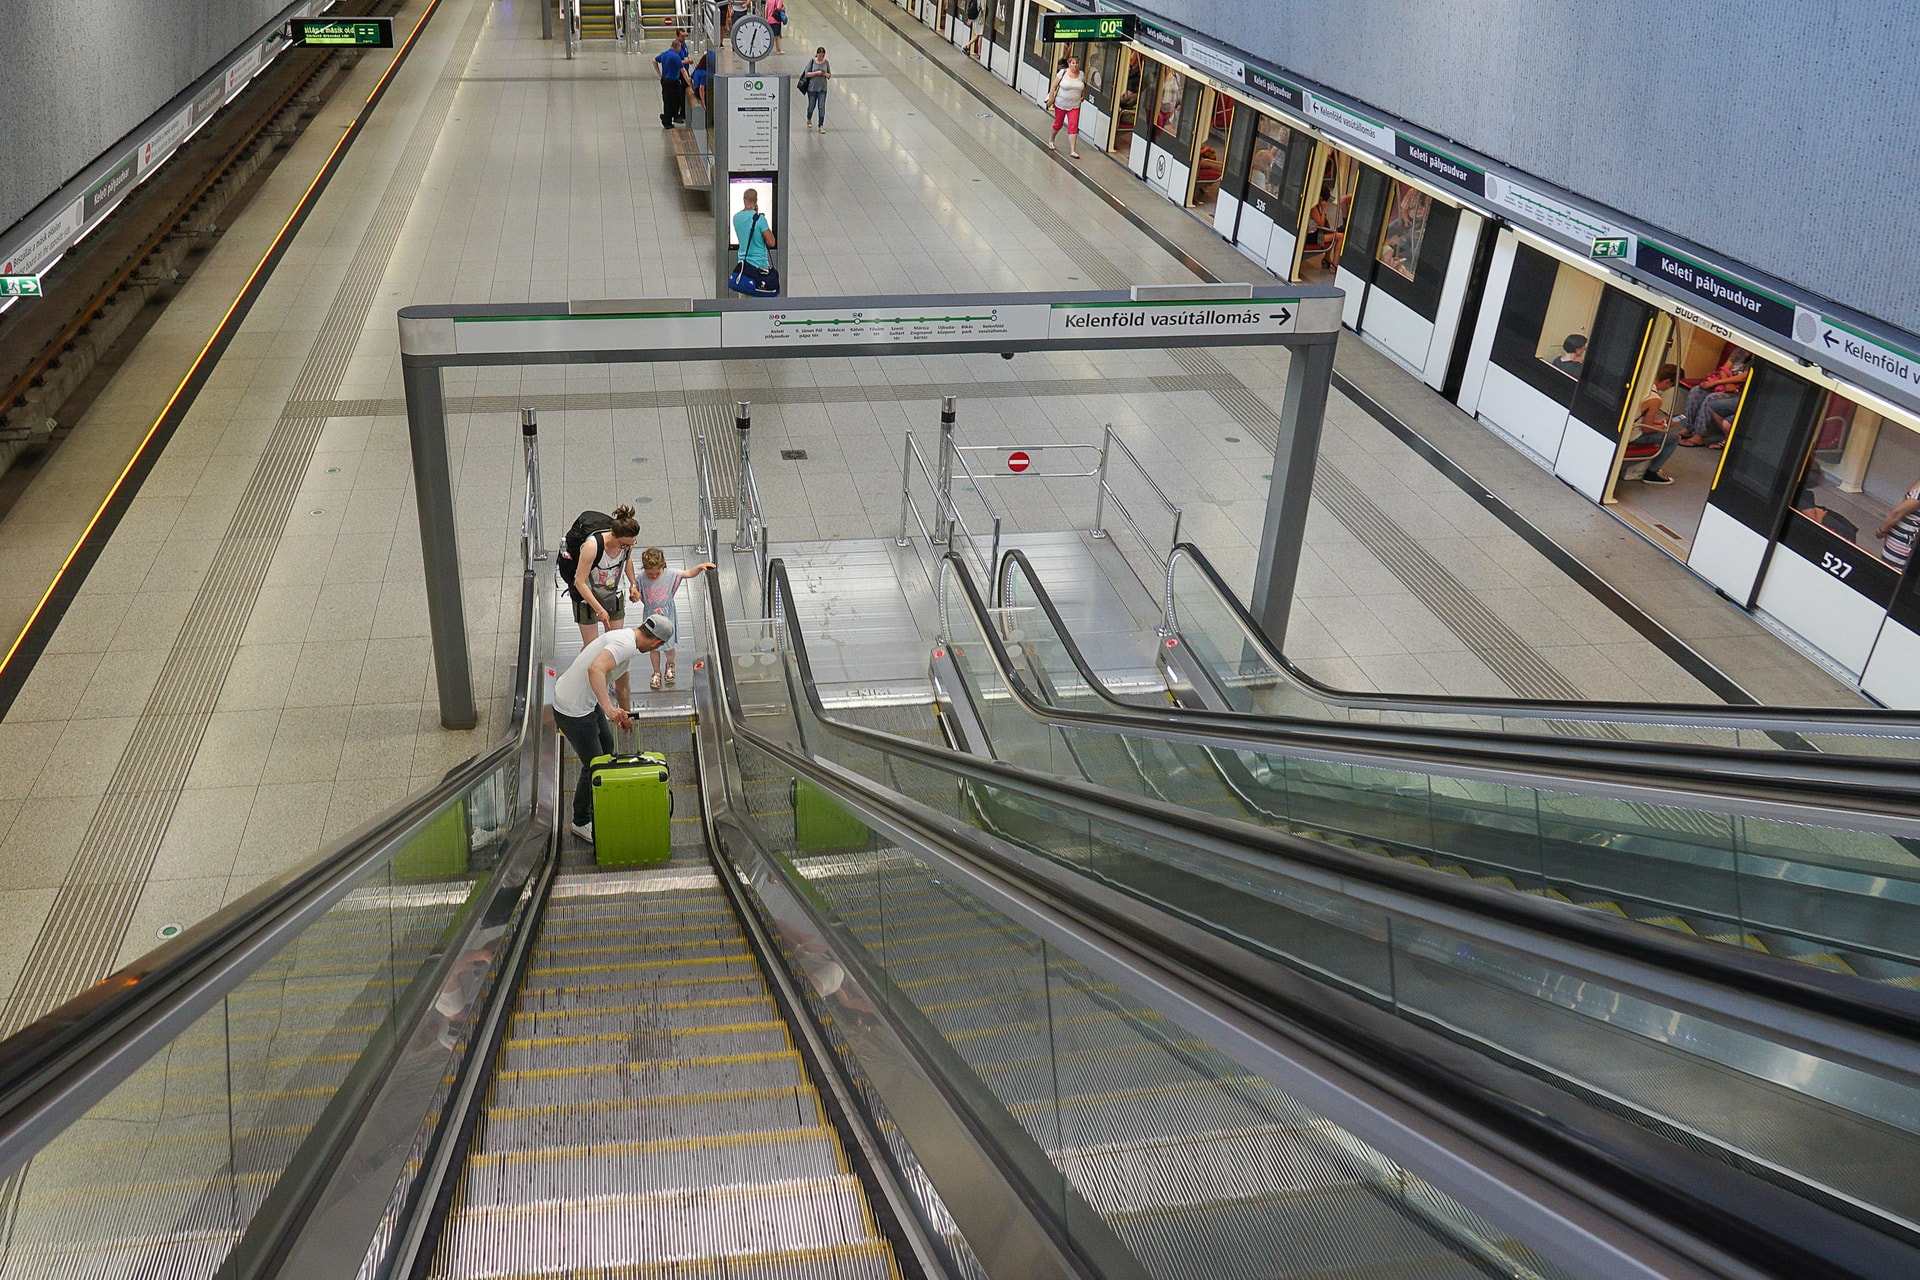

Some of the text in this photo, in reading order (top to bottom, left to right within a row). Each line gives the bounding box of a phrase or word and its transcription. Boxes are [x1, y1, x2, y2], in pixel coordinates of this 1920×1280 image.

[1102, 21, 1116, 33] 00
[1254, 74, 1292, 100] Keleti pályaudvar
[1320, 106, 1376, 139] Kelenföld vasútállomás
[1410, 145, 1467, 181] Keleti pályaudvar
[1662, 258, 1762, 313] Keleti pályaudvar
[1065, 310, 1260, 328] Kelenföld vasútállomás
[1844, 339, 1908, 379] Kelenföld
[1821, 552, 1853, 578] 527
